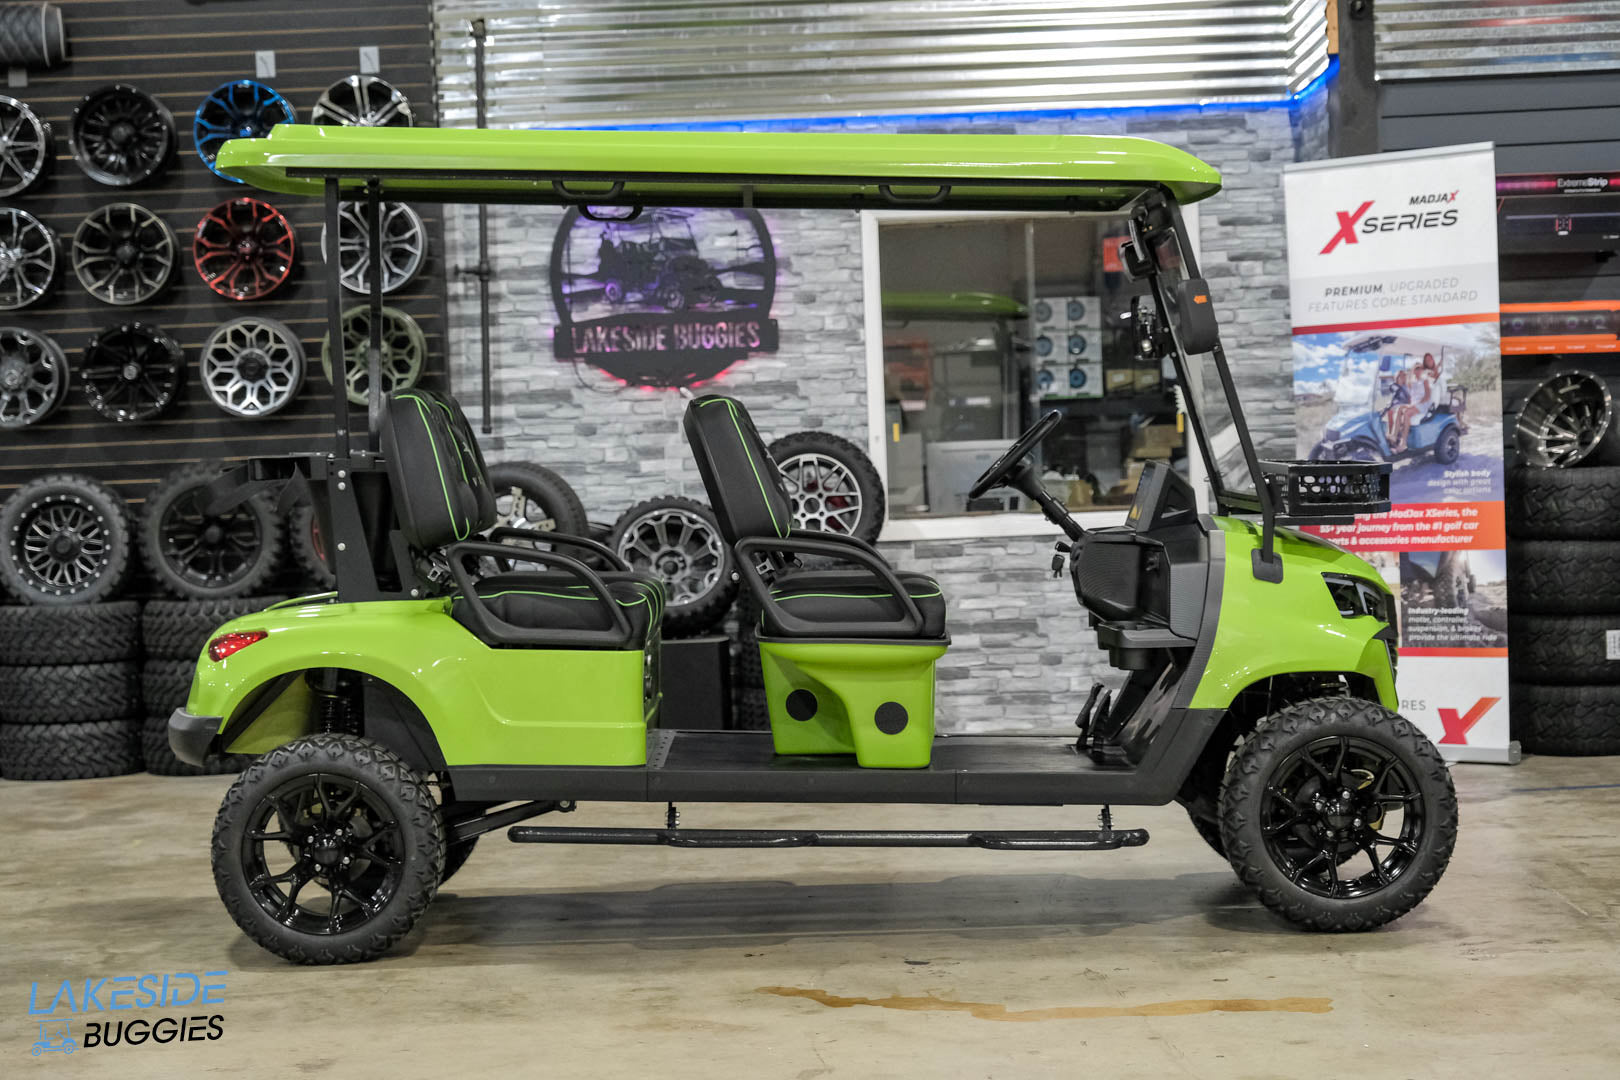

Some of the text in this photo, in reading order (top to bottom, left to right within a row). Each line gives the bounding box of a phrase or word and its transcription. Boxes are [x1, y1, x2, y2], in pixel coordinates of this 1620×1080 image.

[1409, 190, 1460, 205] MADJAX
[1389, 277, 1459, 293] UPGRADED
[1308, 290, 1478, 312] FEATURES COME STANDARD
[674, 321, 761, 350] BUGGIES
[1444, 469, 1492, 479] Stylish body
[1389, 507, 1424, 519] MadJax
[1462, 507, 1478, 517] the
[1335, 525, 1357, 535] year
[1356, 522, 1392, 534] journey
[1392, 521, 1414, 532] from
[1415, 521, 1431, 531] the
[1443, 520, 1463, 532] golf
[1463, 522, 1479, 531] car
[1350, 536, 1358, 546] &
[1359, 534, 1409, 546] accessories
[1410, 533, 1473, 545] manufacturer
[1408, 634, 1435, 642] provide
[1401, 700, 1426, 711] RES
